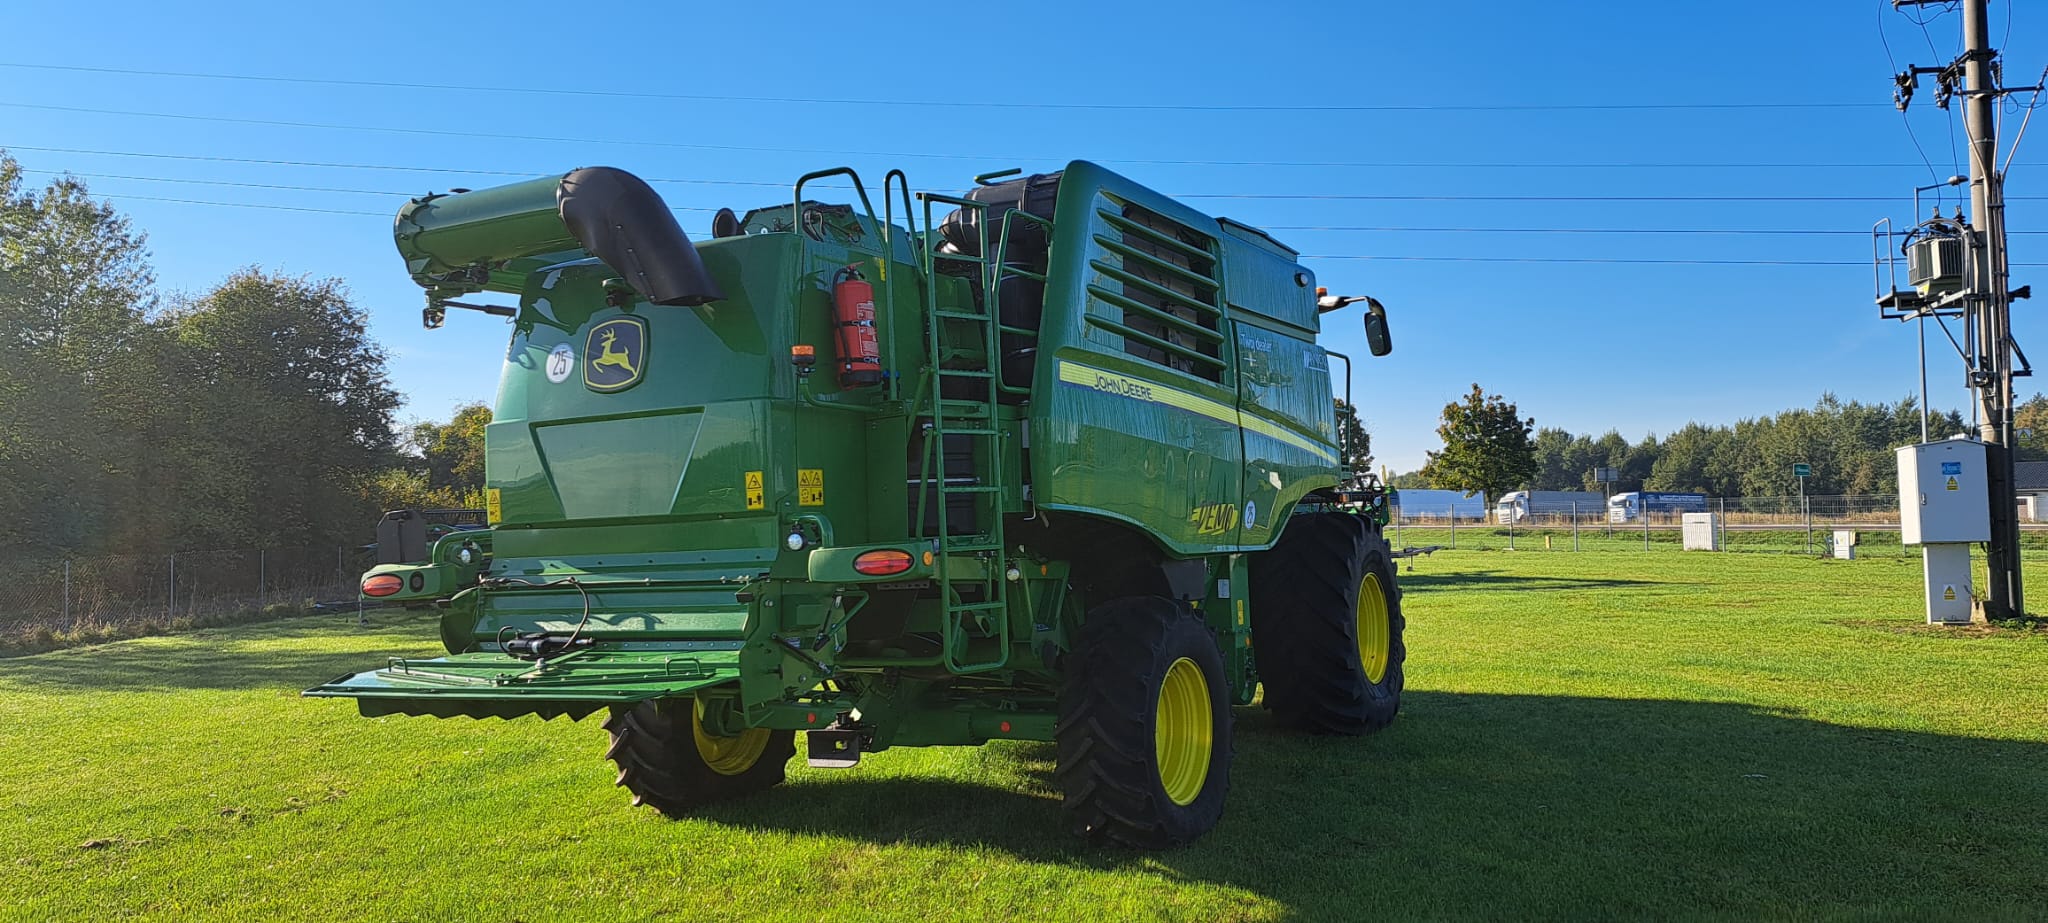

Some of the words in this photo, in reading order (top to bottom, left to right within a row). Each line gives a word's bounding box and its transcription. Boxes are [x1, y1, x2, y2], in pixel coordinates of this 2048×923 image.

[553, 350, 567, 376] 25
[1094, 373, 1120, 393] JOHN
[1120, 378, 1153, 400] DEERE
[1197, 501, 1235, 532] DEMO
